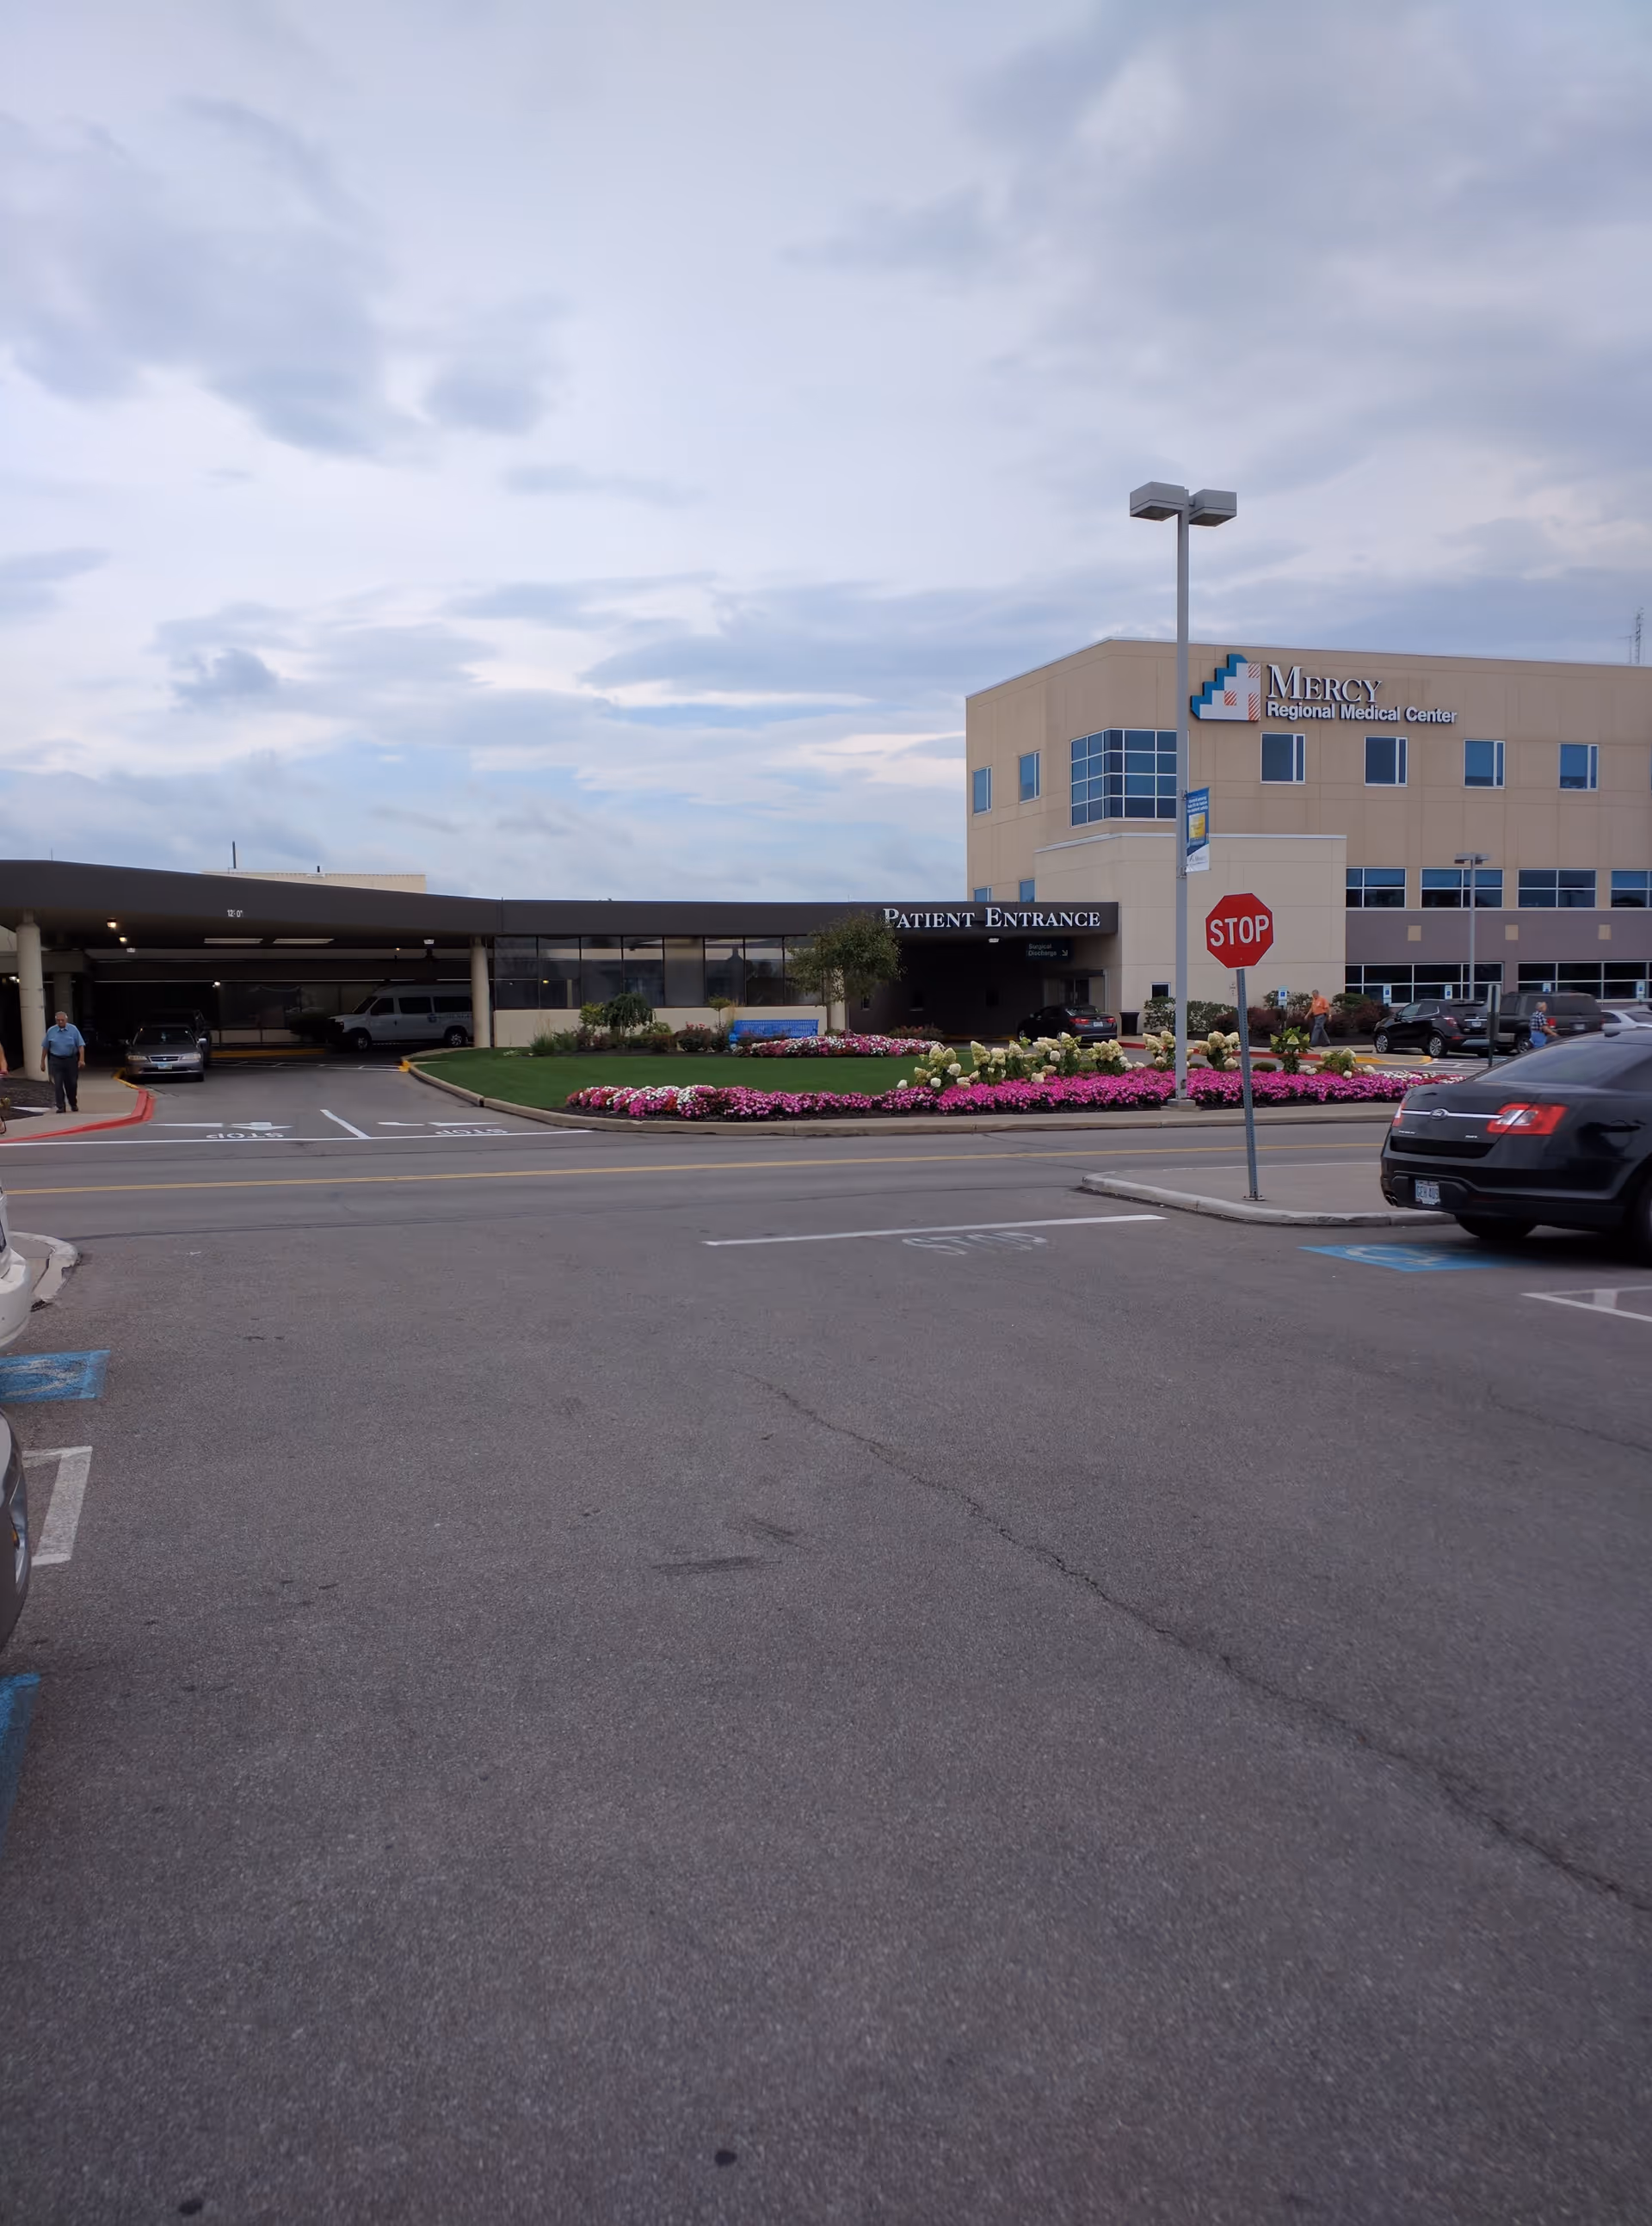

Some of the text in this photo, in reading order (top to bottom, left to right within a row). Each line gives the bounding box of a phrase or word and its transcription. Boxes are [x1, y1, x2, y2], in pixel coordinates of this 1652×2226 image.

[1267, 663, 1383, 703] MERCY
[1267, 701, 1458, 724] Regional Medical Center
[883, 907, 1100, 928] PATIENT ENTRANCE
[1210, 914, 1270, 947] STOP
